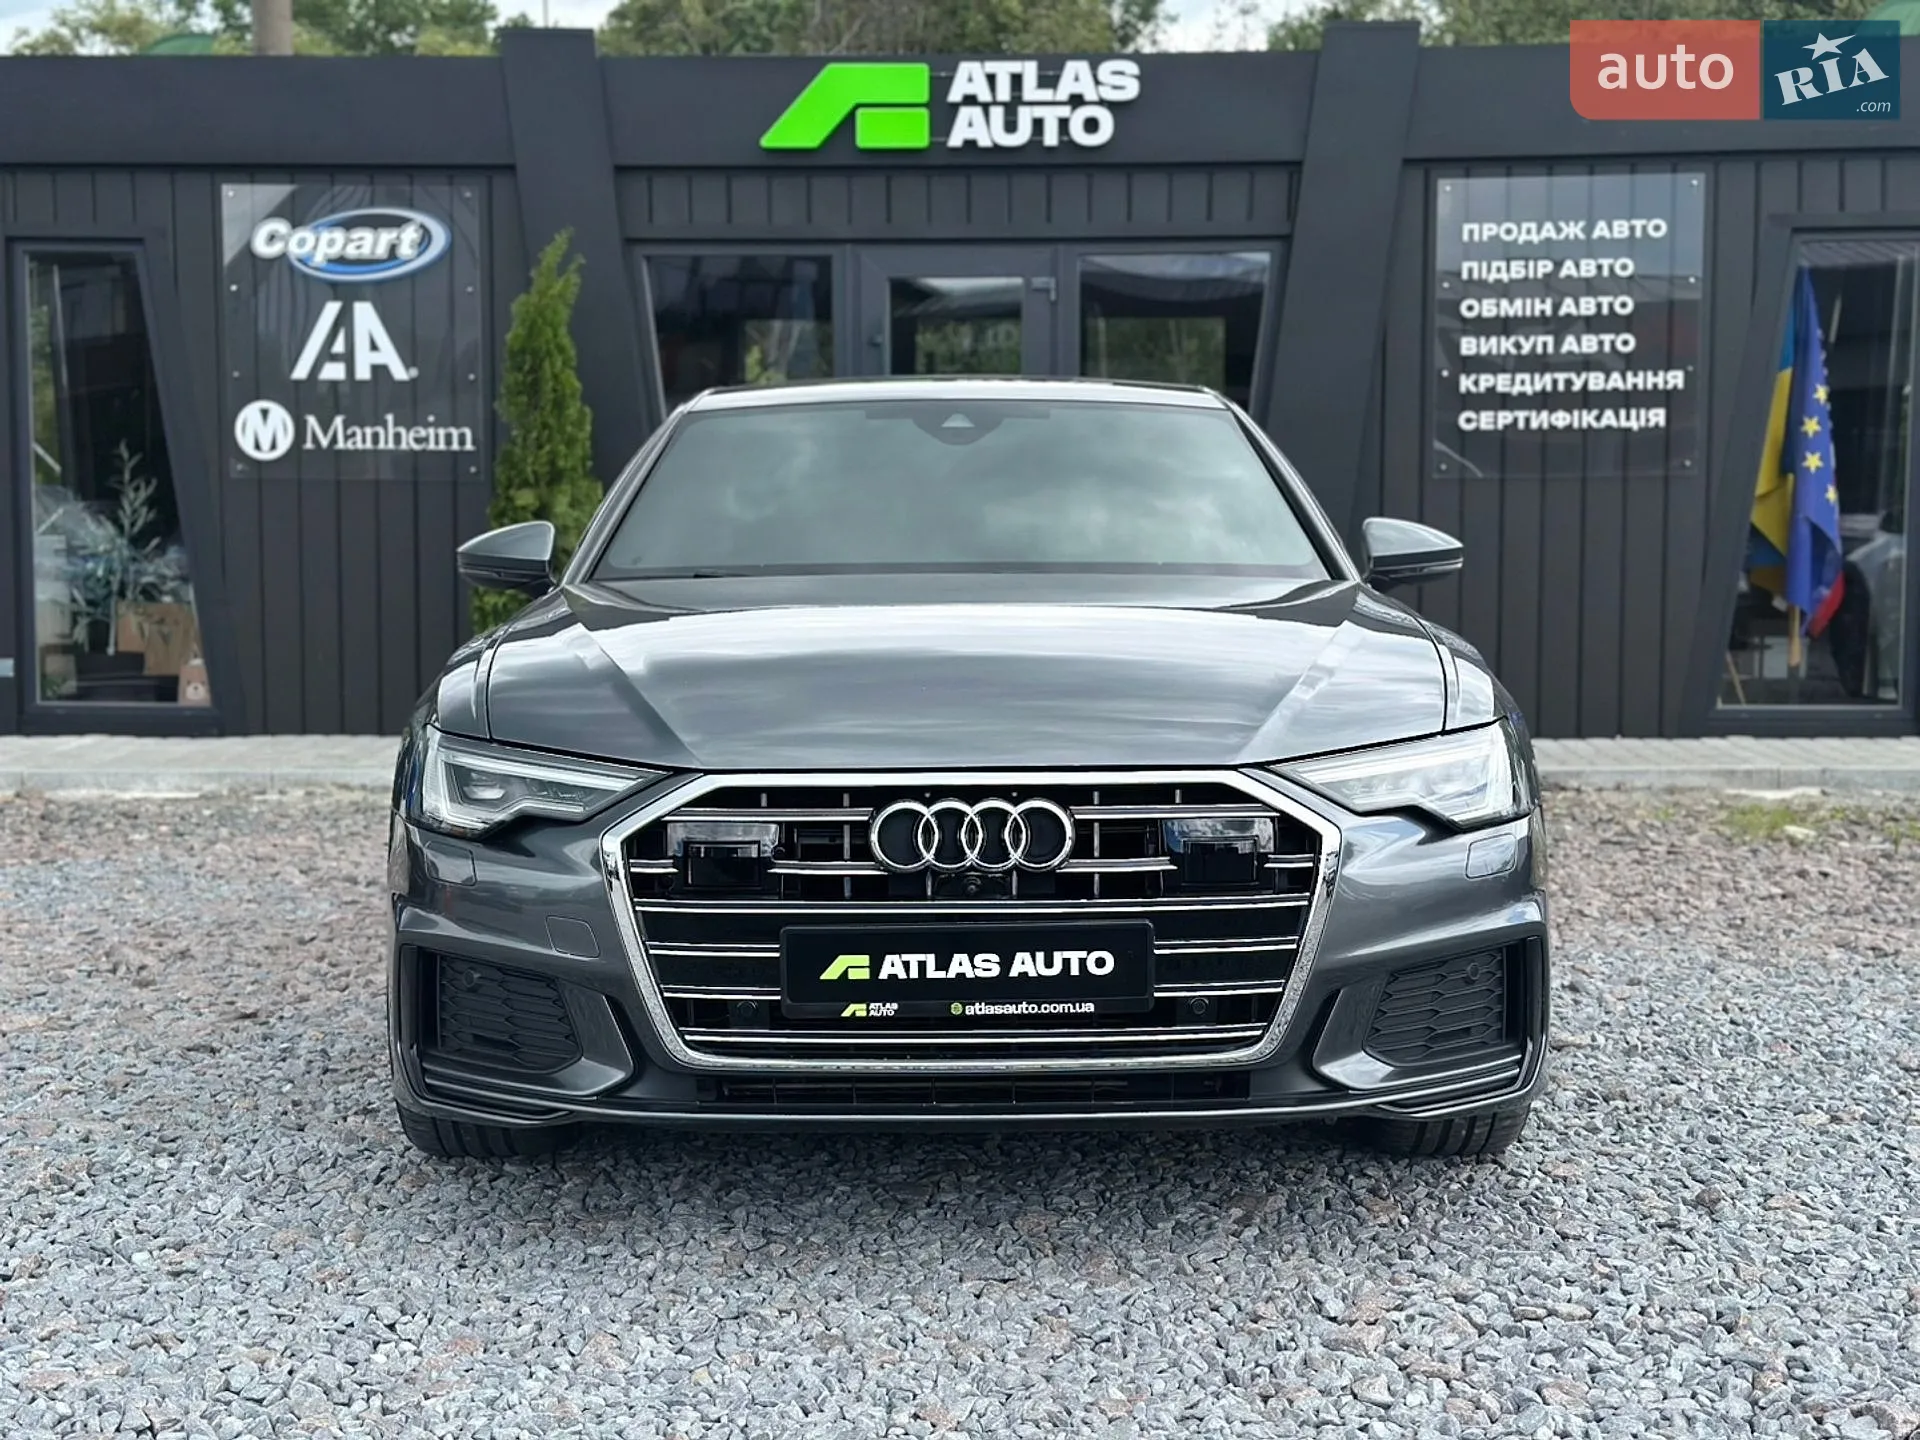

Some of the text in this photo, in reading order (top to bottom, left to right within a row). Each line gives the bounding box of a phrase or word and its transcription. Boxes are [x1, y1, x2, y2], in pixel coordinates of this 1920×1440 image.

[946, 59, 1141, 104] ATLAS
[946, 105, 1115, 149] AUTO
[250, 216, 424, 268] Copart
[1461, 218, 1668, 245] ПРОДАЖ АВТО
[1461, 257, 1635, 283] ПІДБІР АВТО
[1459, 295, 1635, 319] ОБМІН АВТО
[1459, 333, 1637, 356] ВИКУП АВТО
[1458, 369, 1686, 396] КРЕДИТУВАННЯ
[302, 413, 476, 452] Manheim
[1457, 407, 1668, 432] СЕРТИФІКАЦІЯ
[877, 950, 1116, 980] ATLAS AUTO
[868, 1009, 895, 1017] AUTO
[965, 1001, 1095, 1015] atlasauto.com.ua
